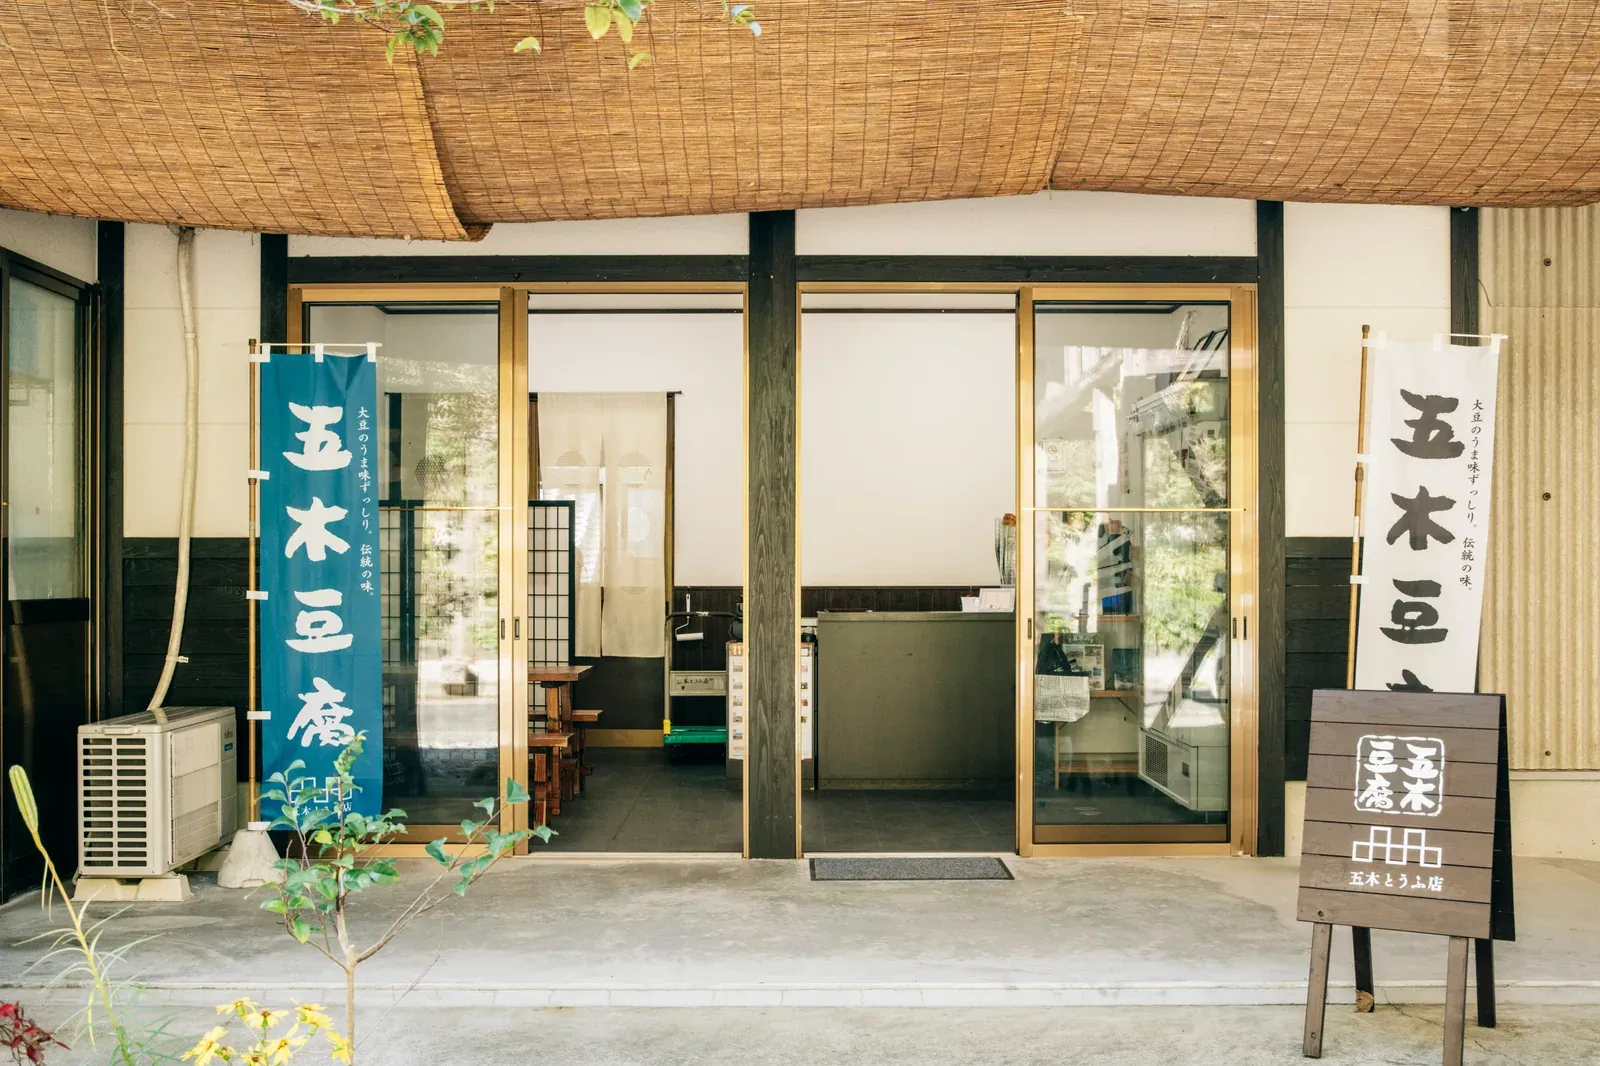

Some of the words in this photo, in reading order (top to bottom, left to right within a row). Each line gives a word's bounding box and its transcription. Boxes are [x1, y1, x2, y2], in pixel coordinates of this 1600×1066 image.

[357, 406, 373, 534] 大豆のうま味ずっしり。
[1466, 398, 1484, 528] 大豆のうま味ずっしり。
[283, 402, 355, 748] 五木豆腐
[359, 543, 374, 595] 伝統の味。
[1379, 389, 1466, 692] 五木豆
[1459, 537, 1475, 592] 伝統の味。
[1358, 741, 1398, 810] 豆腐
[1400, 743, 1440, 811] 五木
[1348, 871, 1444, 892] 五木とうふ店
